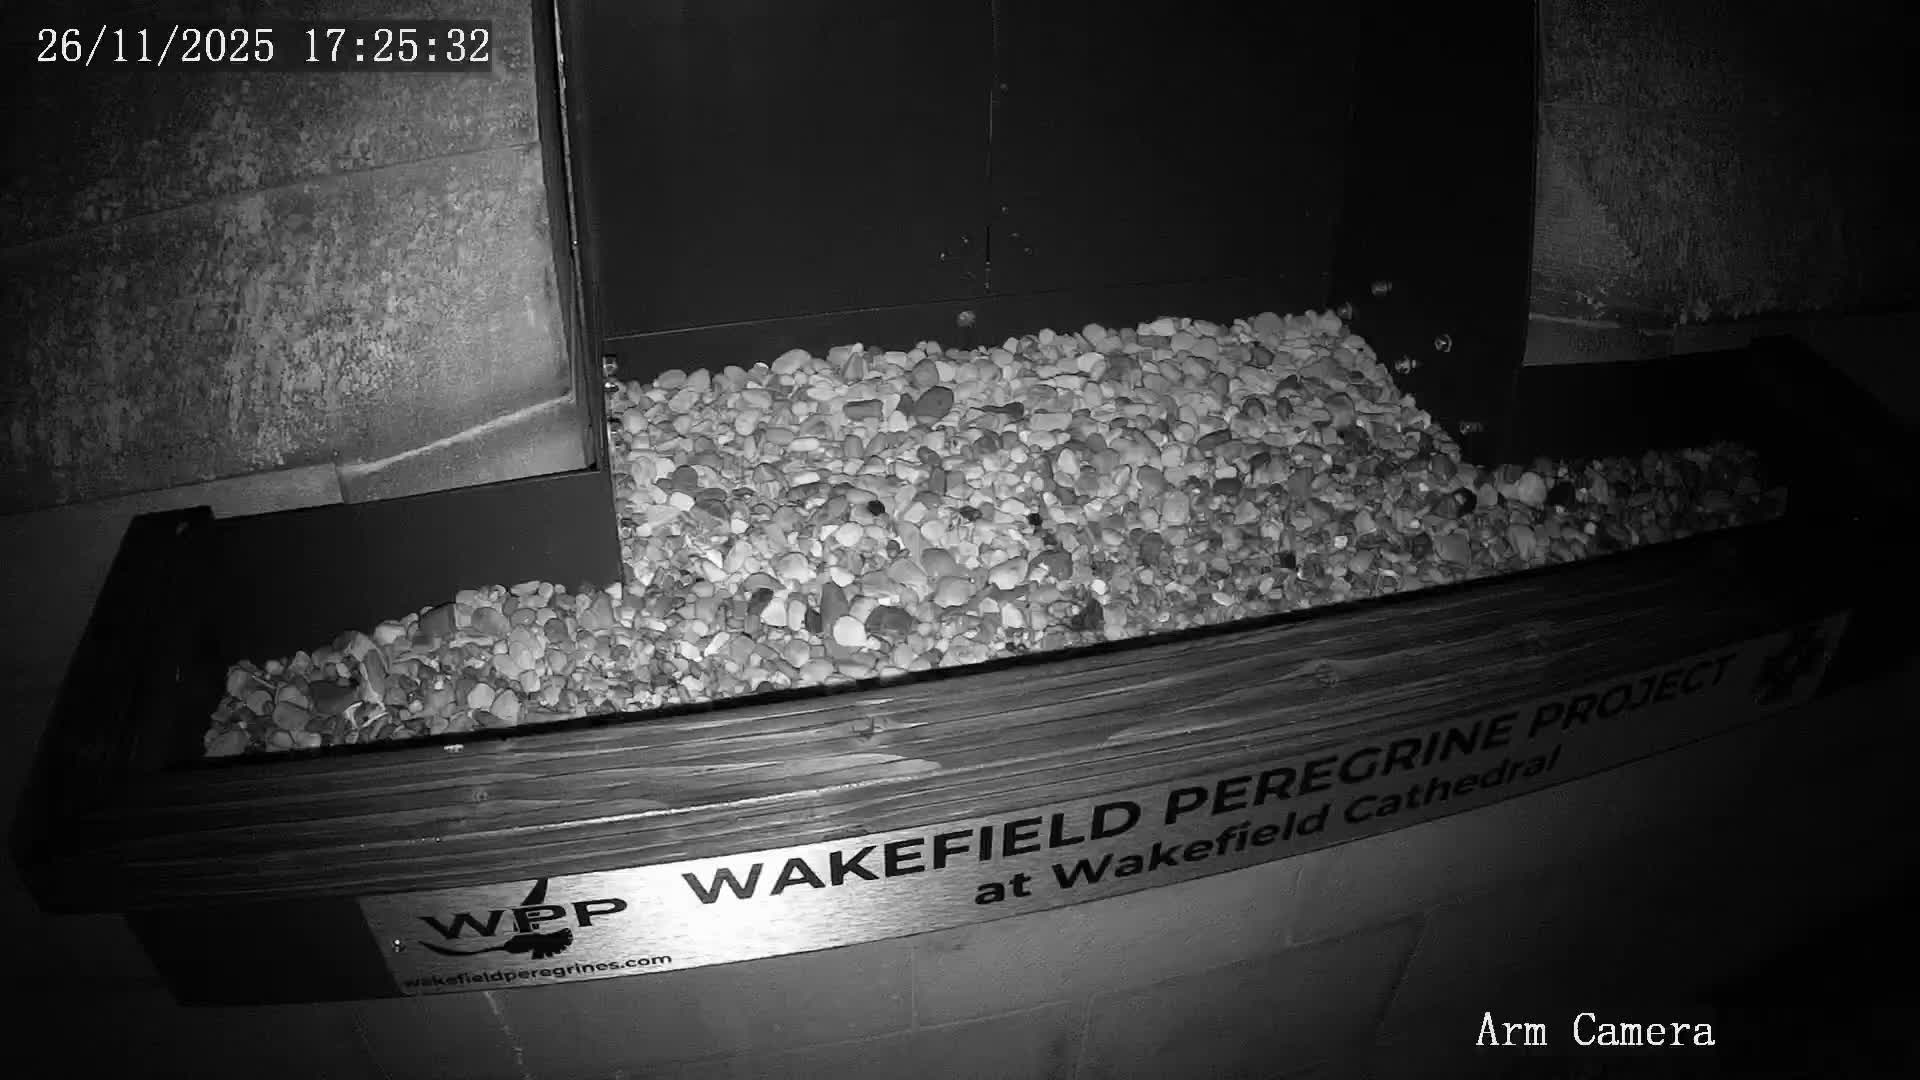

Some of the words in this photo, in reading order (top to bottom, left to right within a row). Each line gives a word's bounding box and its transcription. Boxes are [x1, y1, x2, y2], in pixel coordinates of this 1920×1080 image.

[682, 800, 1142, 904] WAKEFIELD
[1165, 711, 1518, 825] PEREGRINE
[1528, 653, 1738, 738] PROJECT
[974, 872, 1032, 905] at
[1051, 801, 1331, 889] Wakefield
[1343, 745, 1562, 824] Cathedral
[417, 897, 628, 940] WPP
[403, 952, 673, 989] wakefieldperegrines.com
